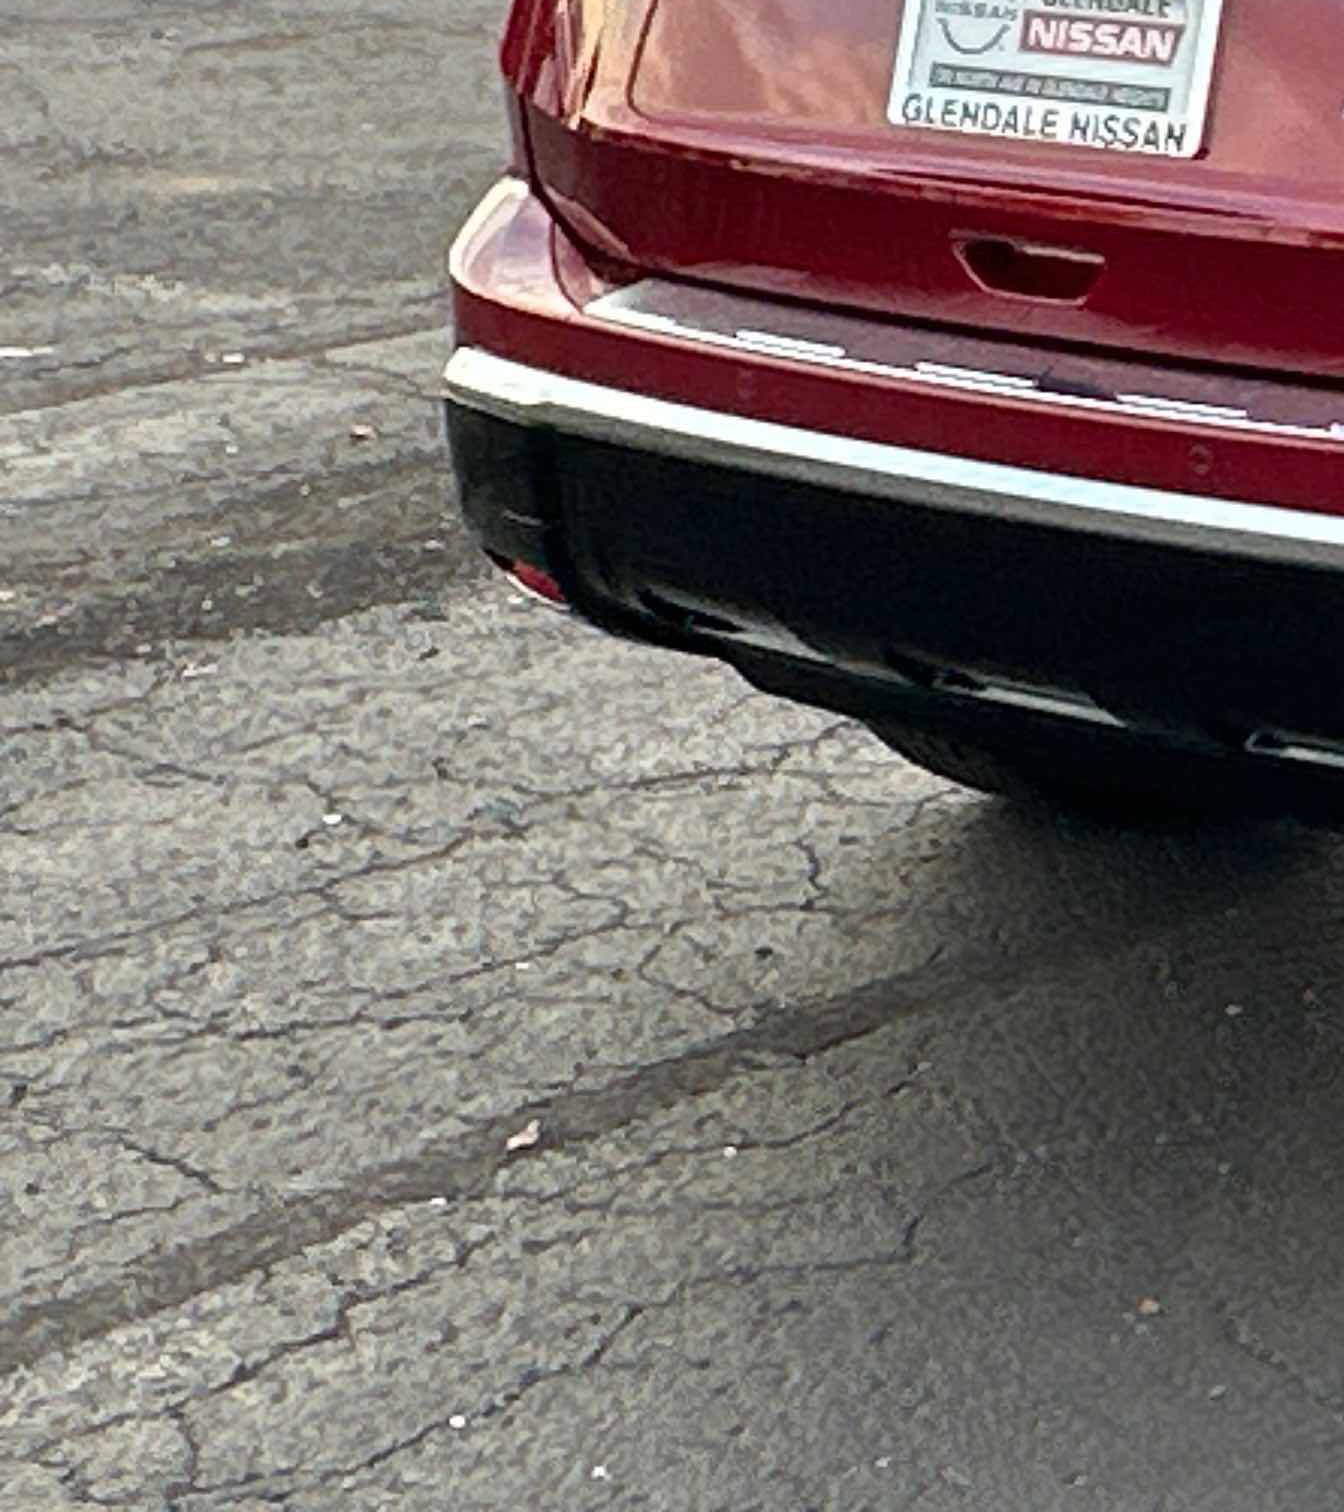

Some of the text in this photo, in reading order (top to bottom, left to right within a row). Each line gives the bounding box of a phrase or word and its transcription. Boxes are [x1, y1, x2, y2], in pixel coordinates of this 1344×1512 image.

[1027, 16, 1176, 61] NISSAN
[901, 92, 1188, 152] GLENDALE NISSAN
